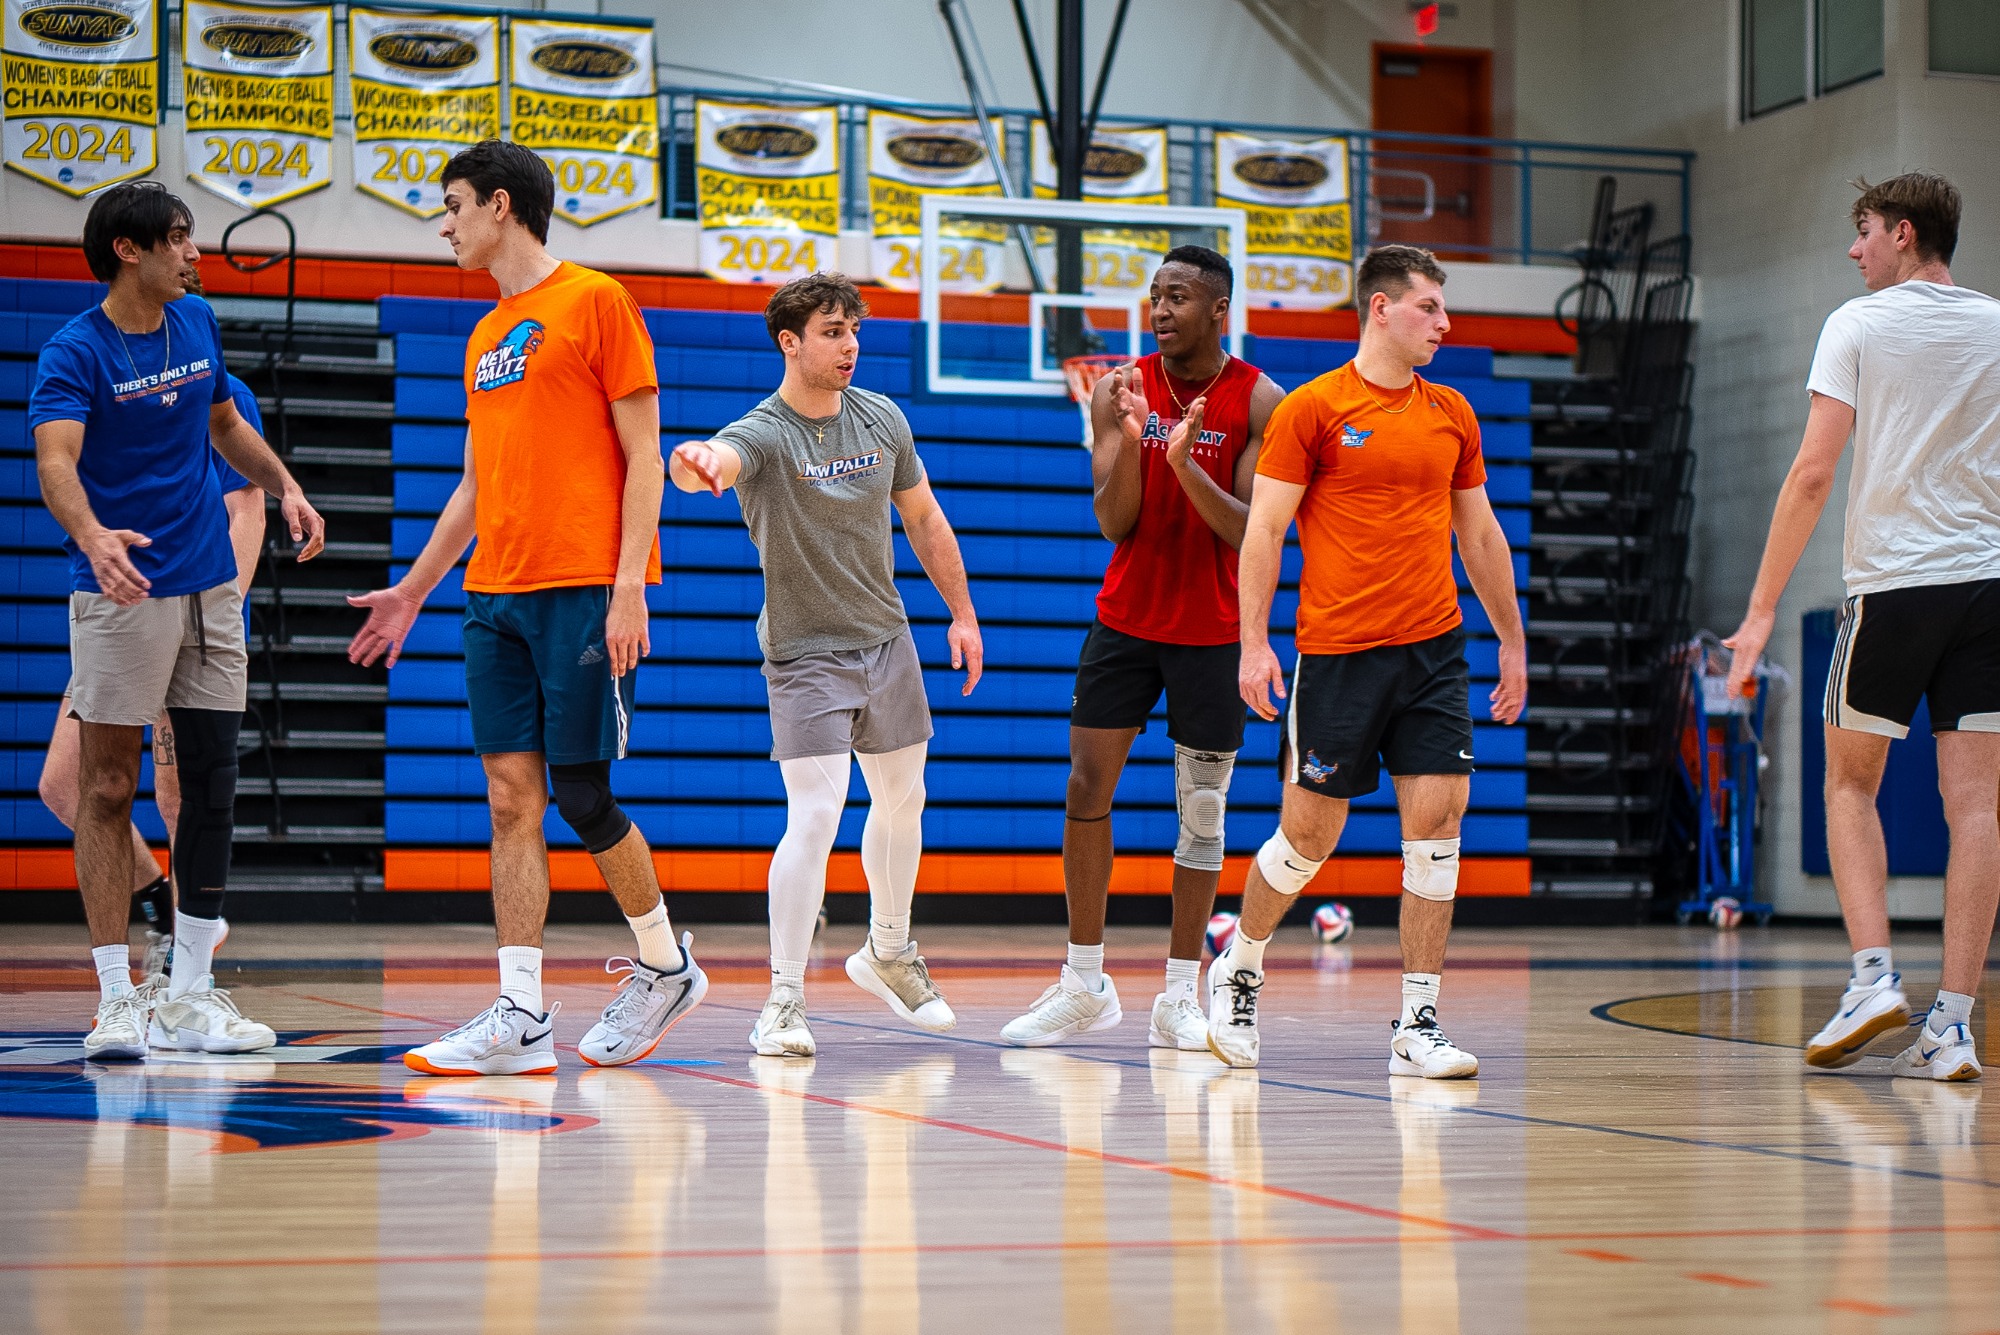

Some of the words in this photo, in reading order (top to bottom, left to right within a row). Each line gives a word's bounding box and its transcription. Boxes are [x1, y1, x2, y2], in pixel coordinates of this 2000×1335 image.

[28, 13, 127, 38] SUNYAC
[4, 59, 67, 86] WOMEN'S
[70, 66, 152, 91] BASKETBALL
[186, 73, 233, 99] MEN'S
[236, 79, 329, 103] BASKETBALL
[4, 87, 153, 115] CHAMPIONS
[354, 84, 433, 110] WOMEN'S
[516, 95, 651, 125] BASEBALL
[185, 100, 330, 129] CHAMPIONS
[354, 111, 495, 138] CHAMPIONS
[22, 121, 135, 164] 2024
[203, 136, 312, 178] 2024
[372, 145, 450, 184] 202
[702, 175, 834, 201] SOFTBALL
[718, 235, 818, 273] 2024
[1247, 263, 1344, 292] 025-26
[473, 354, 529, 391] PALTZ
[476, 345, 515, 374] NEW
[112, 374, 158, 394] THERE'S
[160, 365, 188, 382] ONLY
[190, 358, 210, 372] ONE
[489, 373, 521, 388] HAWKS
[162, 391, 178, 406] NP
[803, 461, 831, 479] NW
[832, 451, 880, 476] PALTZ
